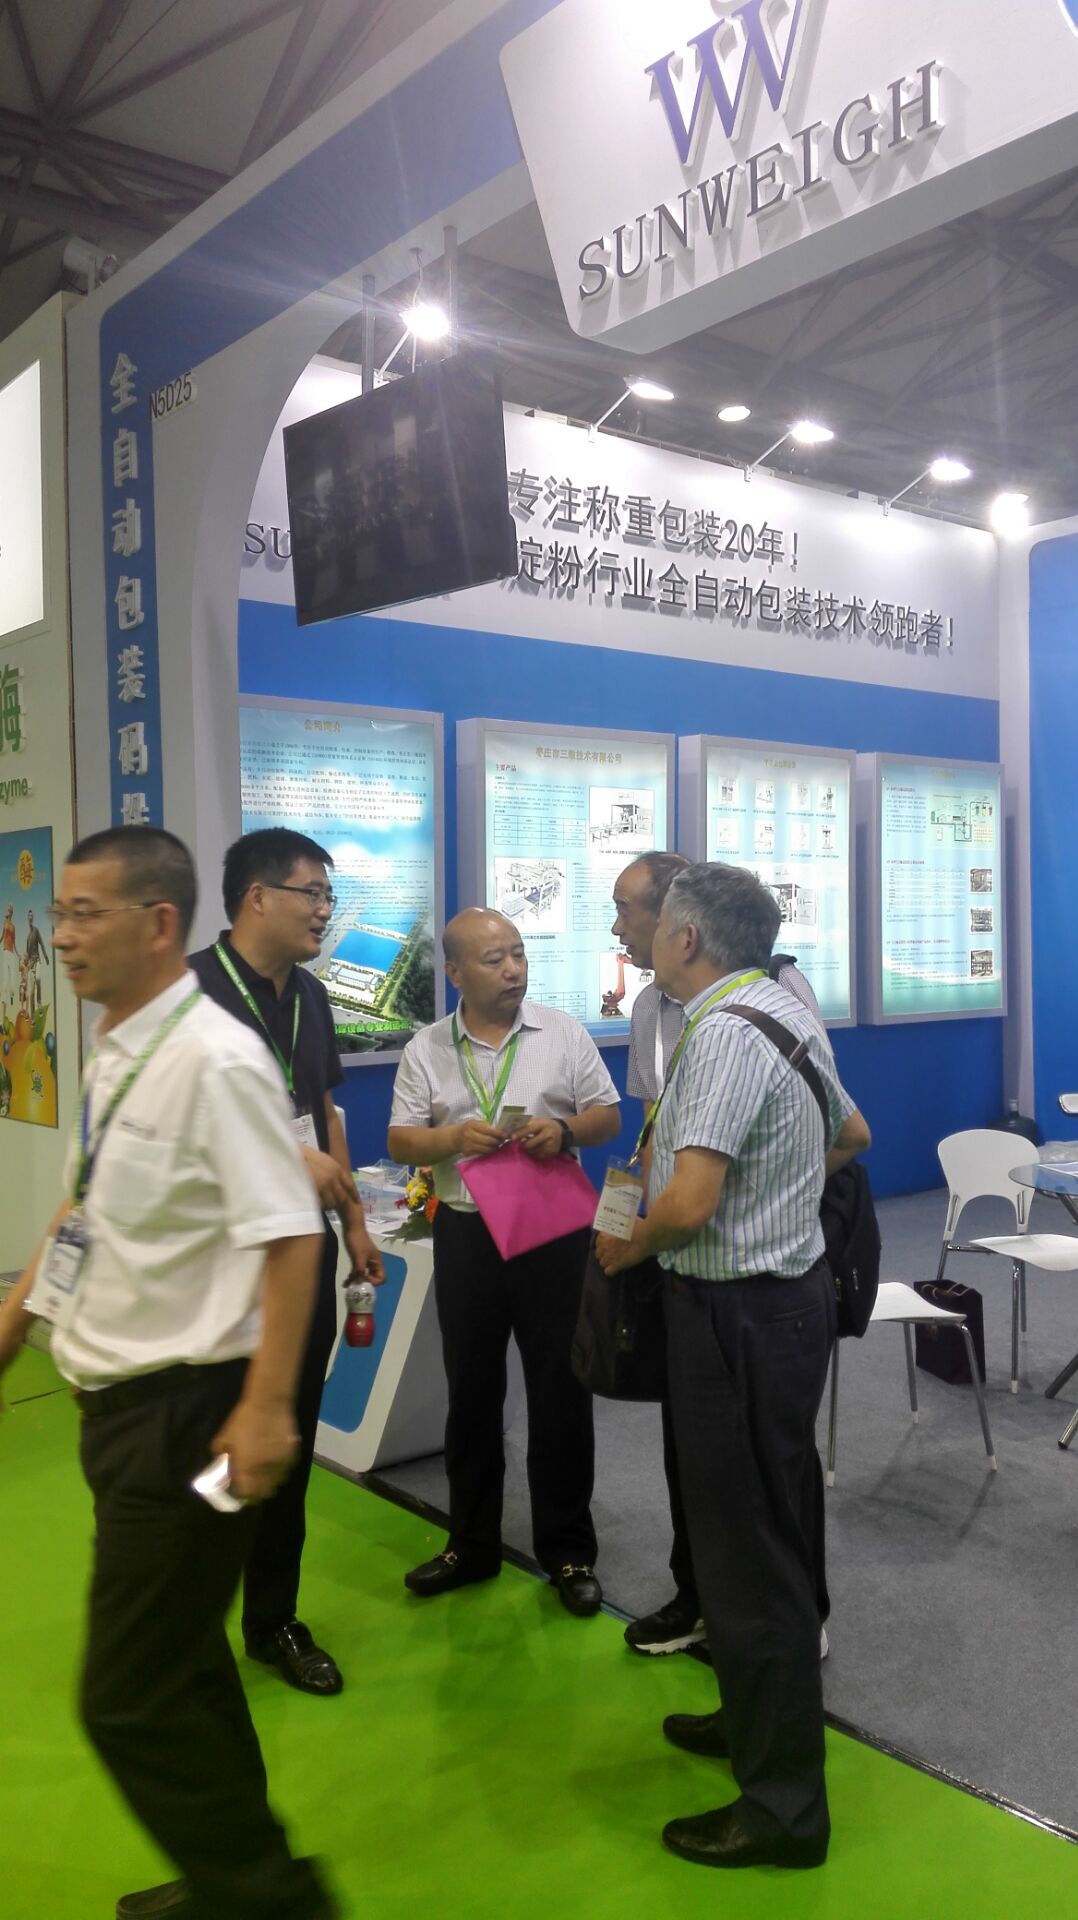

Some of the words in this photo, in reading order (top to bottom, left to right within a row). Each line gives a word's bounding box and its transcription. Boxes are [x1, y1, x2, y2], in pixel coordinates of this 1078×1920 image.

[578, 60, 939, 300] SUNWEIGH
[150, 372, 193, 419] N5D25
[508, 468, 798, 566] 专注称重包装20年！
